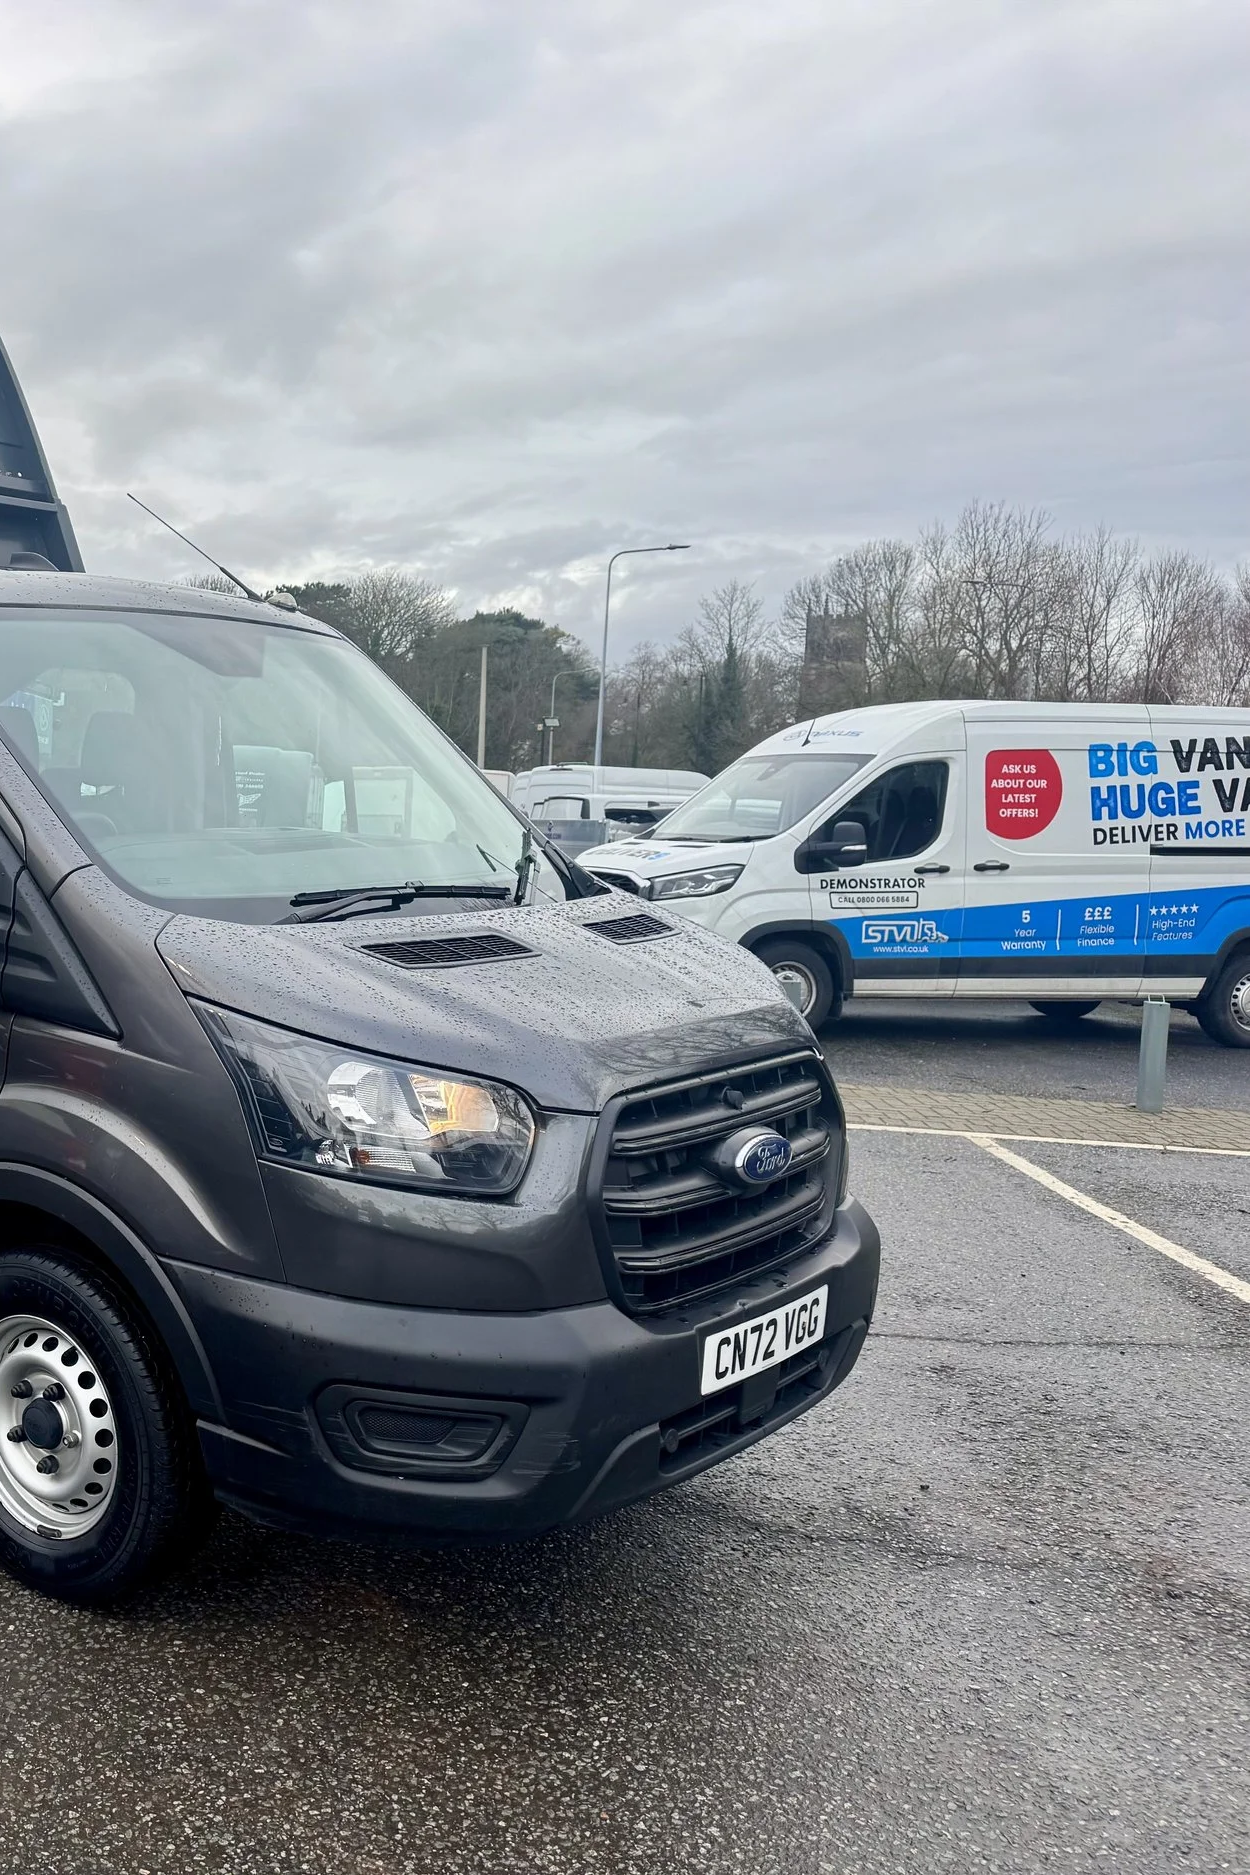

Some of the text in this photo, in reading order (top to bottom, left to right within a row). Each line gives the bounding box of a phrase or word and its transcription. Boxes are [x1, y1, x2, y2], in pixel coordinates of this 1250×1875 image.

[1088, 736, 1250, 778] BIG VAN
[1002, 764, 1037, 774] ASK US
[991, 779, 1047, 788] ABOUT OUR
[1001, 793, 1037, 803] LATEST
[1090, 780, 1201, 821] HUGE
[999, 808, 1039, 818] OFFERS!
[1093, 818, 1246, 846] DELIVER MORE
[820, 878, 925, 889] DEMONSTRATOR
[1021, 910, 1031, 923] 5
[1084, 907, 1112, 920] £££
[1079, 924, 1115, 935] Flexible
[1152, 918, 1196, 930] High-End
[1014, 928, 1036, 937] Year
[1152, 931, 1193, 941] Features
[1001, 940, 1046, 951] Warranty
[1077, 938, 1115, 947] Finance
[873, 945, 928, 953] www.stvl.co.uk
[756, 1143, 786, 1175] Ford
[714, 1297, 820, 1381] CN72 VGG
